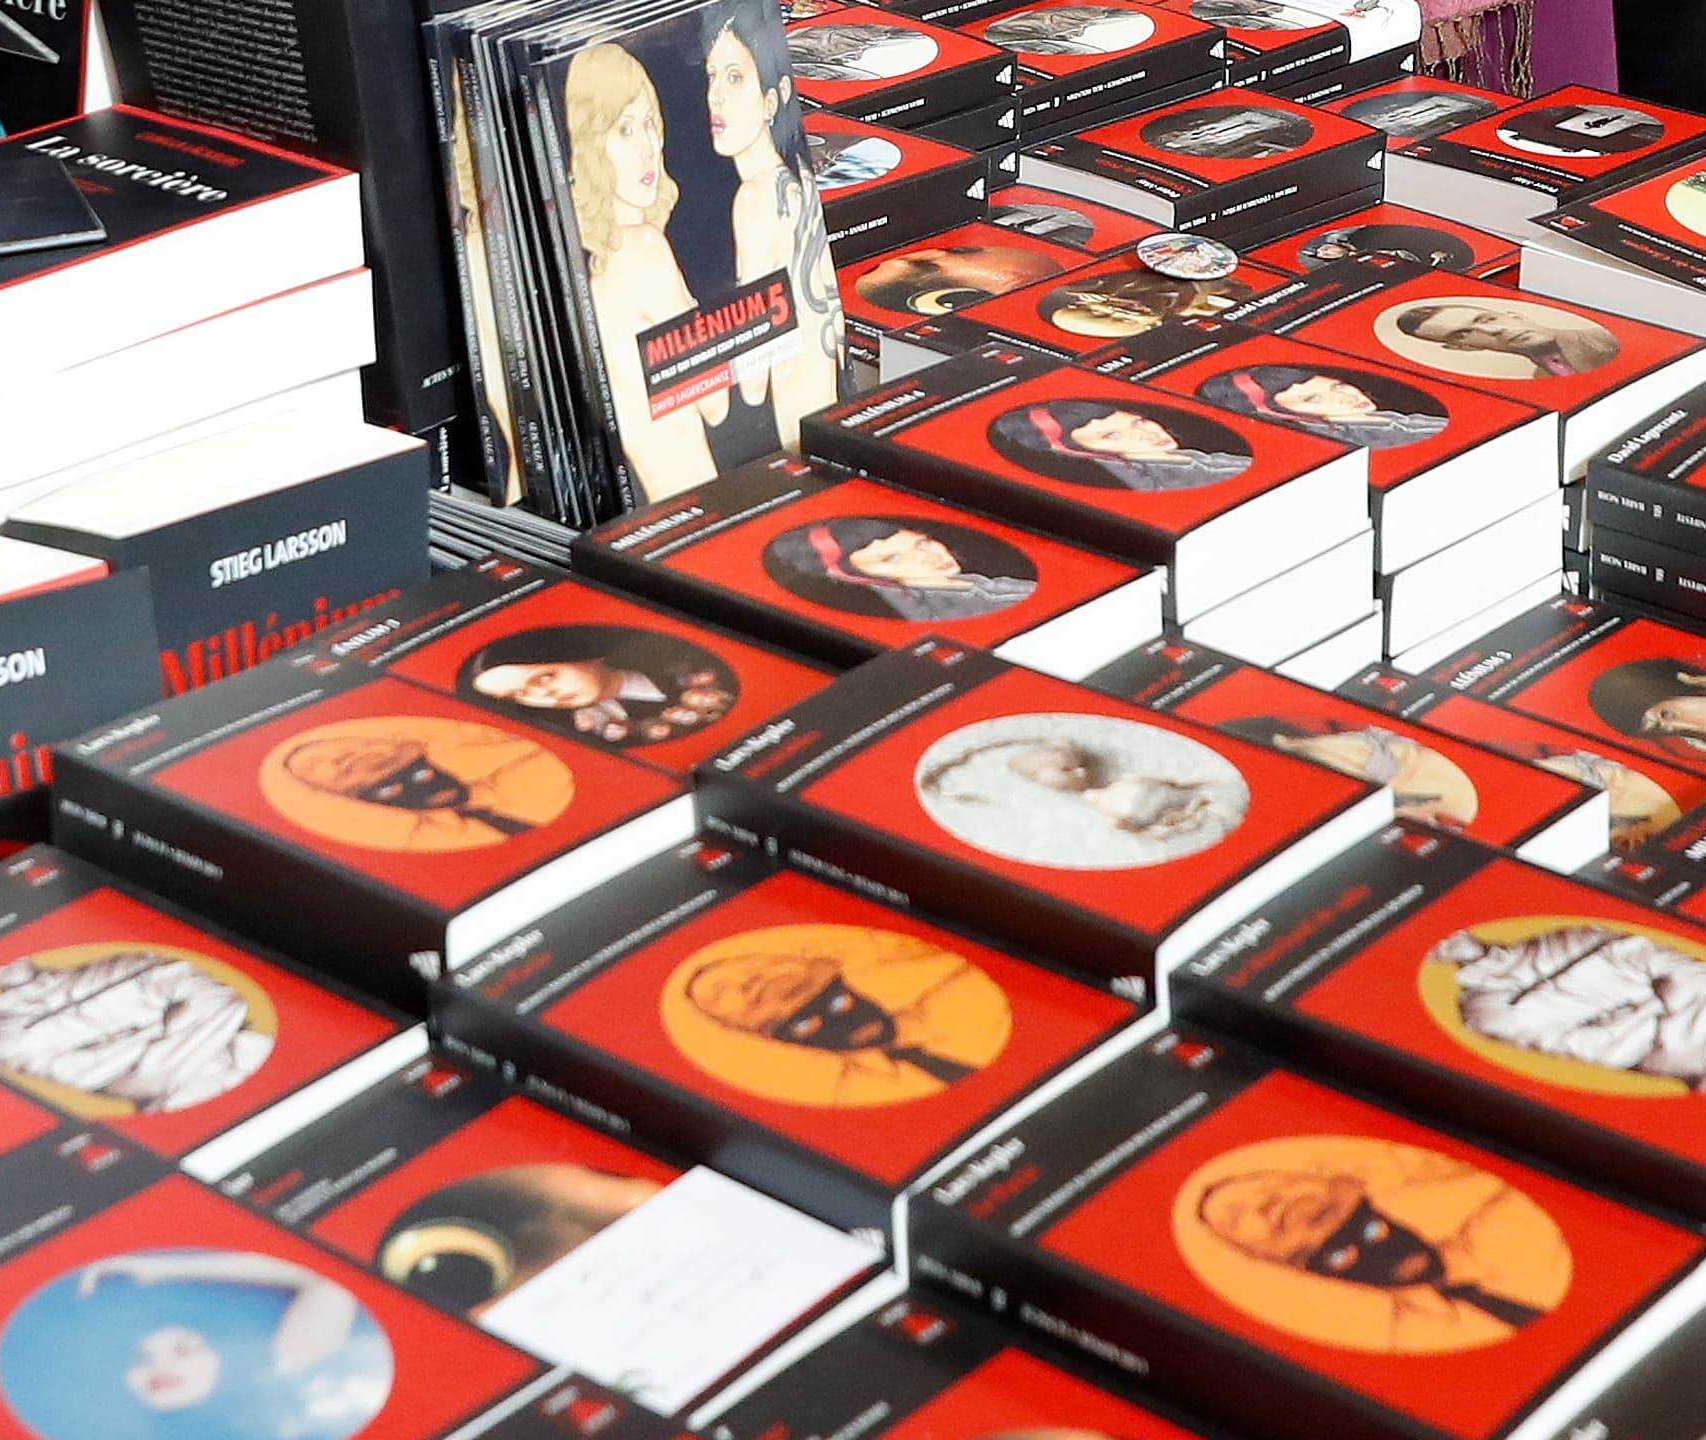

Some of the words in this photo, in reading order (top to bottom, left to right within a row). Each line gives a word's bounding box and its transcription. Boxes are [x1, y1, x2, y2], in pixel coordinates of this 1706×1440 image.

[25, 136, 81, 160] La
[77, 153, 229, 202] sorcière
[1222, 301, 1262, 321] David
[1250, 281, 1309, 308] Lagercrantz
[645, 292, 768, 368] MILLÉNIUM
[767, 282, 790, 326] 5
[650, 372, 662, 385] LA
[660, 365, 677, 380] FILLE
[676, 359, 691, 373] QUI
[690, 346, 718, 368] RENDAIT
[717, 338, 735, 354] COUP
[734, 329, 754, 346] POUR
[753, 321, 771, 338] COUP
[652, 395, 677, 414] DAVID
[676, 368, 730, 403] LAGERCRANTZ
[1606, 439, 1641, 464] David
[1632, 409, 1688, 445] Lagercrantz
[1597, 490, 1620, 505] NOIR
[1620, 496, 1645, 512] BABEL
[209, 547, 263, 588] STIEG
[263, 519, 347, 569] LARSSON
[1600, 553, 1622, 567] NOIR
[1623, 559, 1648, 576] BABEL
[1449, 655, 1505, 690] LLÉNIUM
